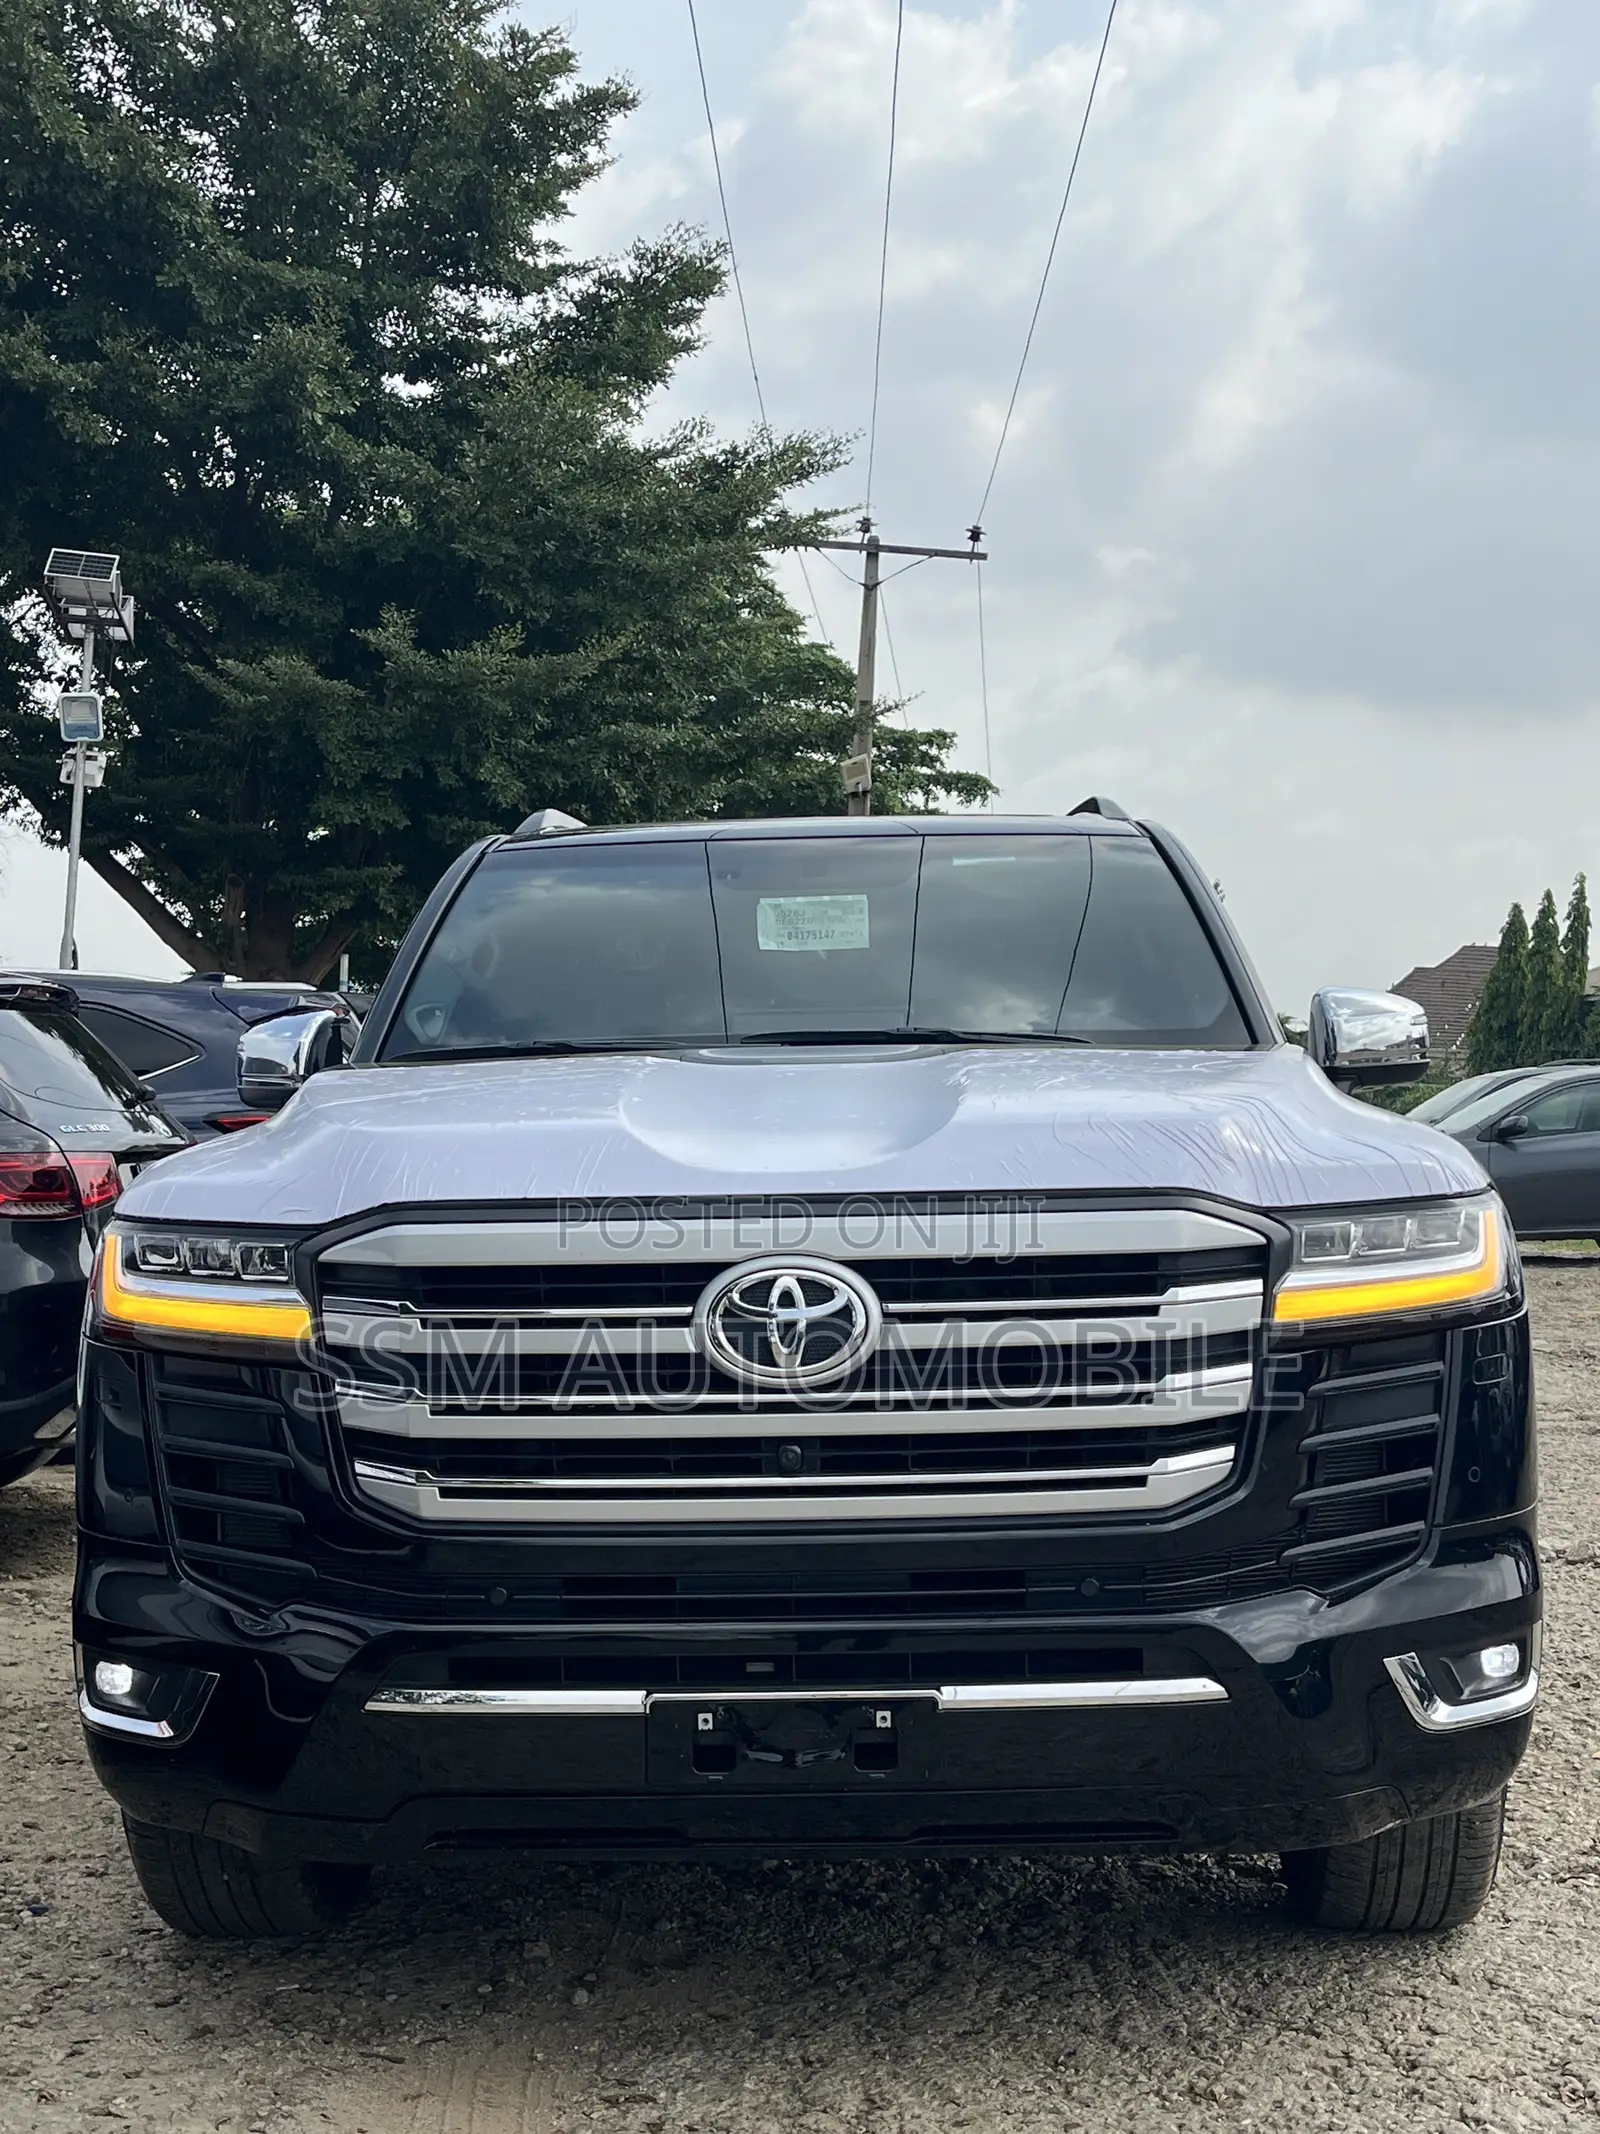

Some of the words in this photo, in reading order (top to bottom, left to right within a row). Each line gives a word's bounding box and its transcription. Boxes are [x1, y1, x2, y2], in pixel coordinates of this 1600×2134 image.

[787, 929, 836, 941] 04175147
[60, 1124, 86, 1133] GLC
[87, 1124, 110, 1132] 300
